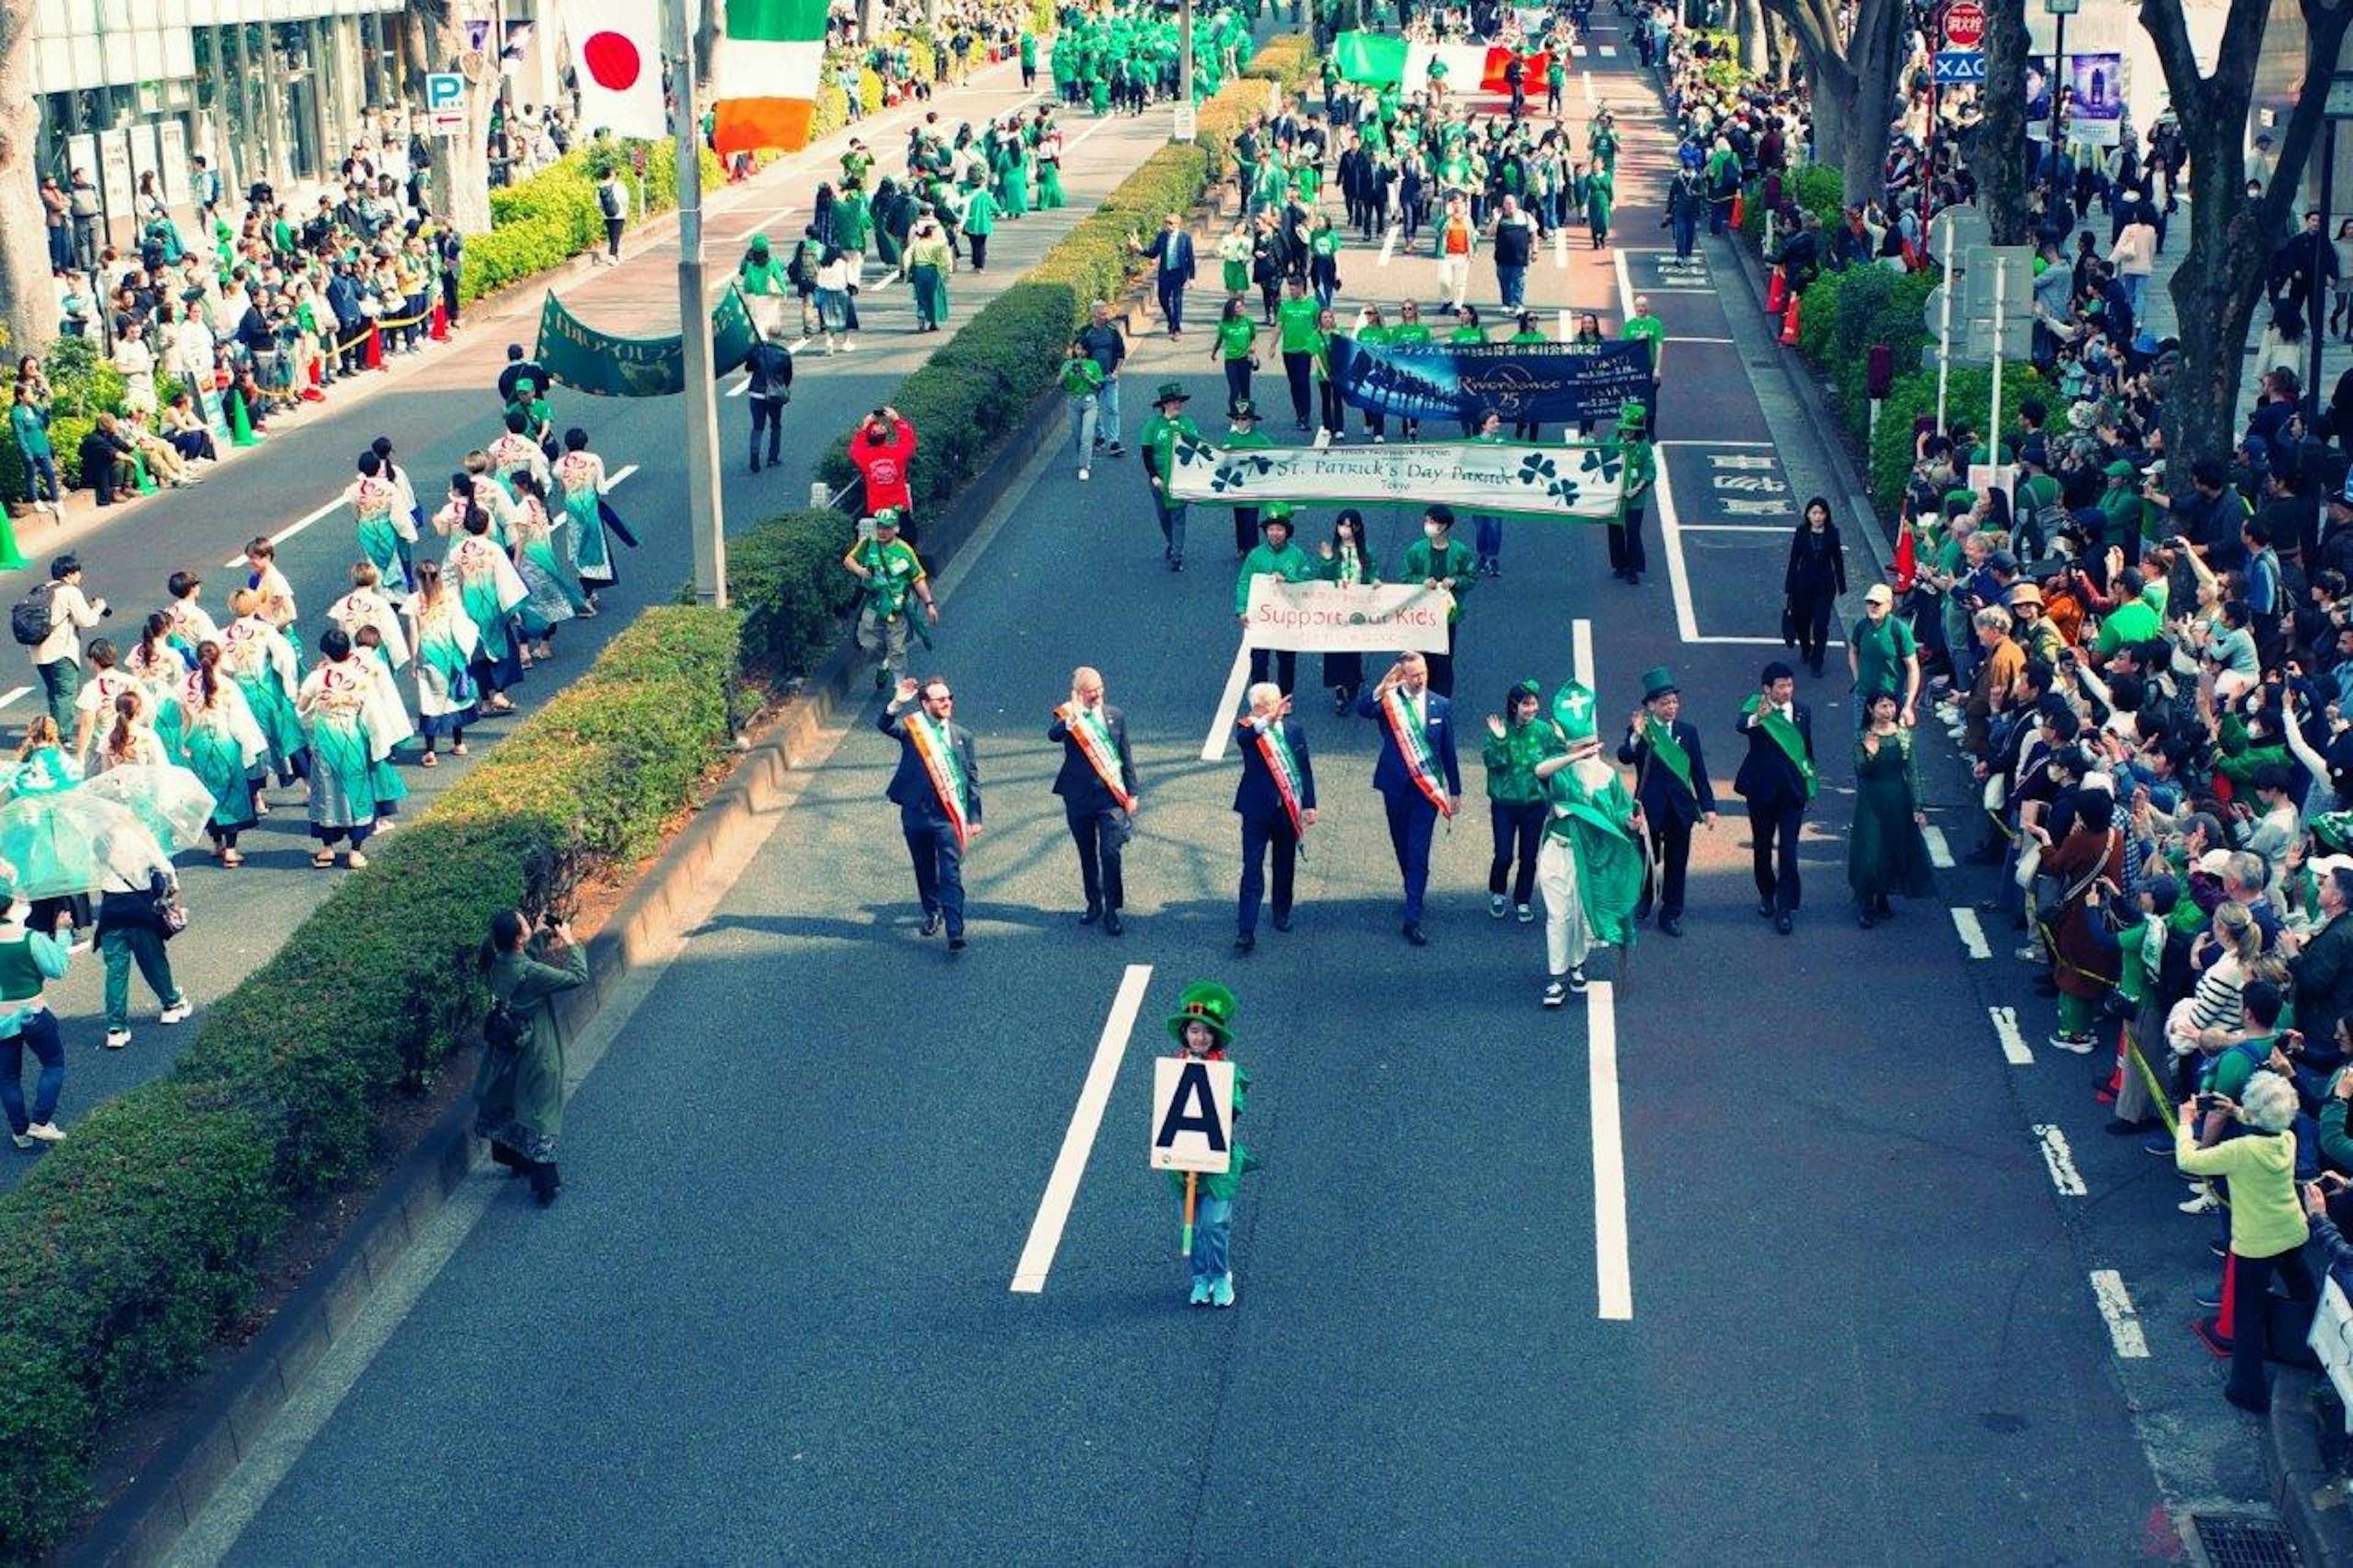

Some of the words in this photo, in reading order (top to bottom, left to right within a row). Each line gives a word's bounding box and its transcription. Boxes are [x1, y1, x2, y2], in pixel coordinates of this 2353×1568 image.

[1947, 16, 1983, 32] 消火栓
[432, 77, 460, 108] P
[1458, 373, 1561, 396] Riverdance
[1499, 392, 1520, 409] 25
[1408, 464, 1442, 484] Day
[1260, 604, 1343, 629] Support
[1395, 607, 1437, 627] Kids
[1156, 1063, 1227, 1152] A
